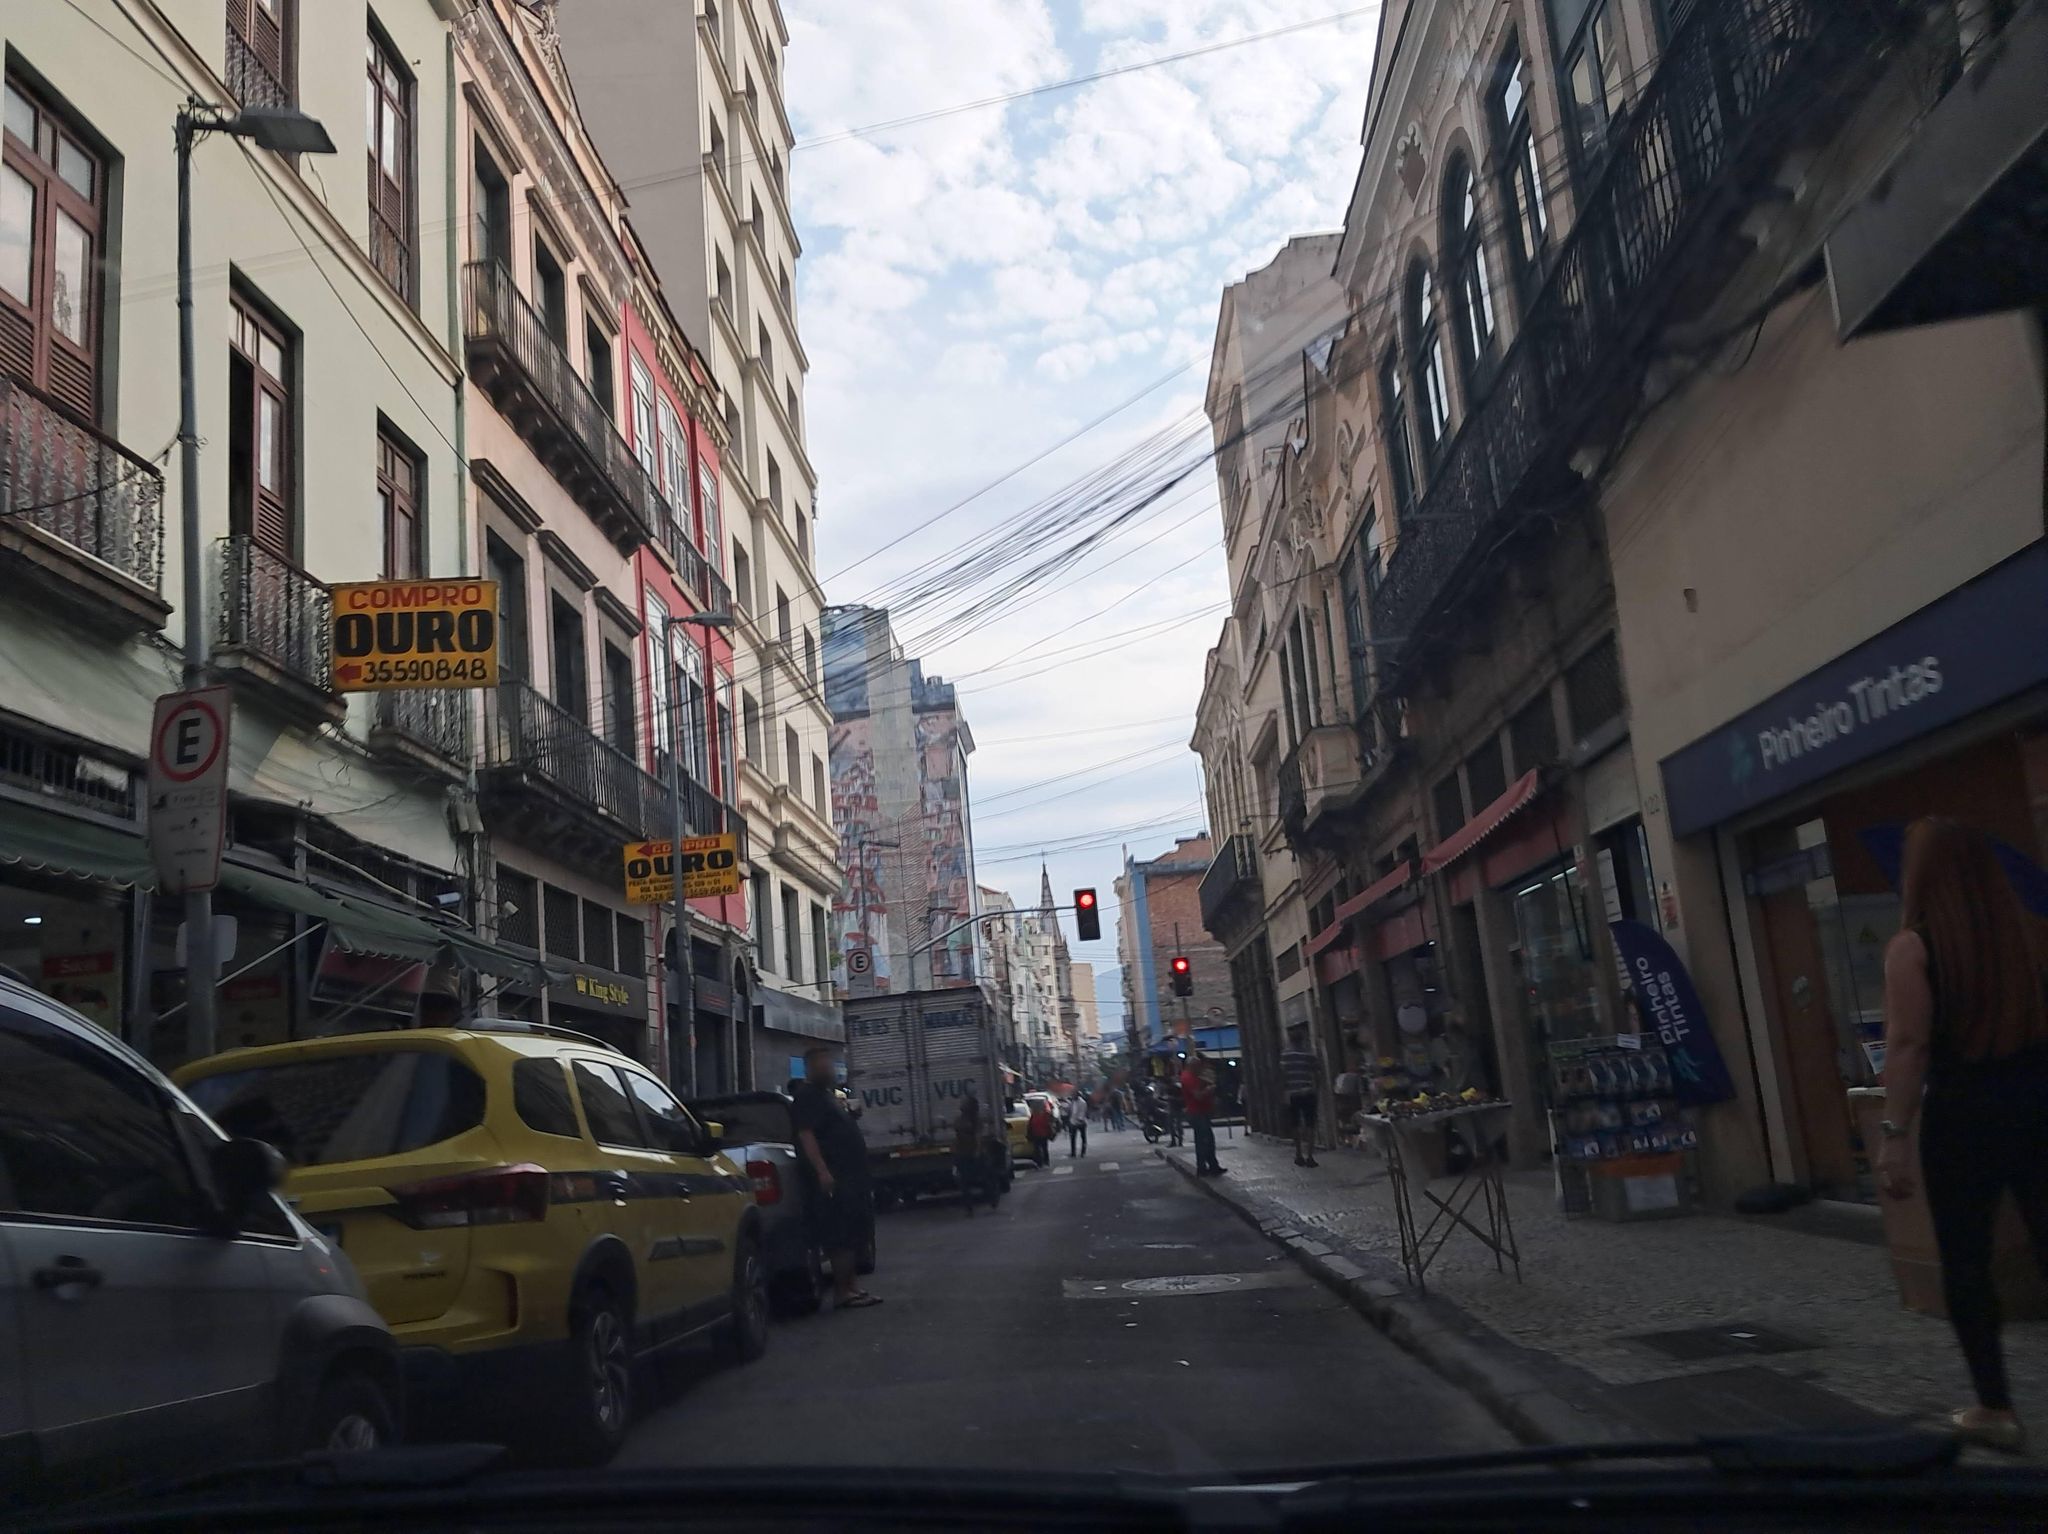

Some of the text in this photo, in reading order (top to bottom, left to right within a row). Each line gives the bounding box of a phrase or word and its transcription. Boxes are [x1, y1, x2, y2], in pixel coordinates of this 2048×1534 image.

[350, 585, 482, 610] COMPRO
[335, 609, 493, 657] OURO
[362, 658, 487, 684] 35590848
[1758, 656, 1943, 770] Pinheiro Tintas
[176, 717, 201, 765] E
[652, 839, 716, 854] COPRO
[628, 848, 734, 879] OURO
[855, 955, 864, 969] E
[588, 977, 629, 1007] King Style
[1636, 956, 1690, 1046] Pinheiro Tintas
[862, 1087, 903, 1108] VUC
[934, 1079, 977, 1100] VUC
